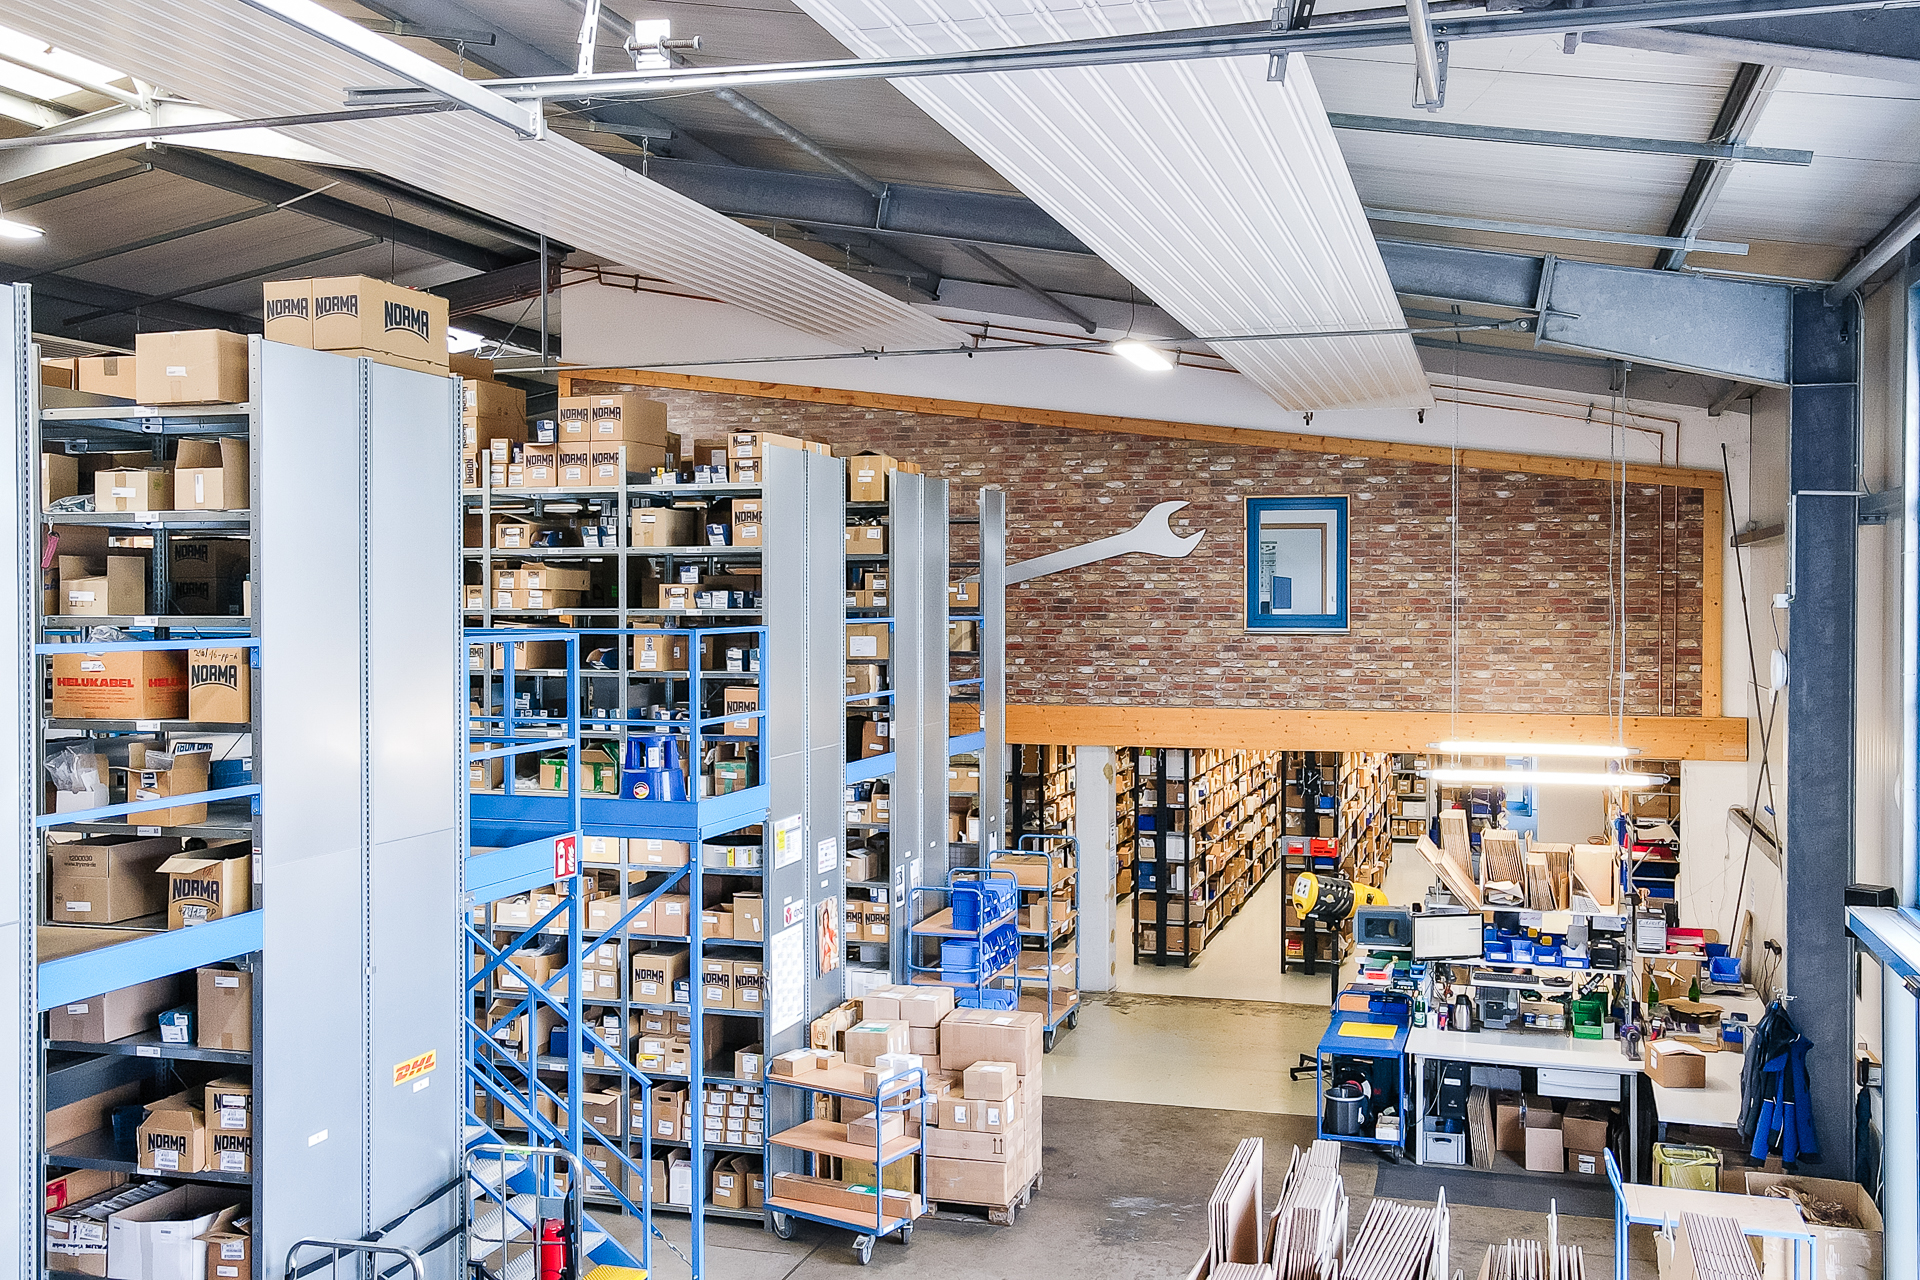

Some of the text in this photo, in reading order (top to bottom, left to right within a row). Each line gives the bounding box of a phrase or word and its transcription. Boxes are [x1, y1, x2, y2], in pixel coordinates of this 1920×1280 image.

[267, 298, 308, 318] NORMA
[316, 295, 358, 316] NORMA
[385, 301, 429, 339] NORMA
[560, 409, 589, 421] NORMA
[593, 407, 621, 420] NORMA
[526, 455, 553, 467] NORMA
[560, 453, 588, 467] NORMA
[466, 459, 474, 484] NORMA
[57, 678, 134, 687] HELUKABEL
[192, 665, 237, 687] NORMA
[727, 702, 755, 712] NORMA
[173, 879, 219, 903] NORMA
[635, 969, 663, 983] NORMA
[395, 1053, 436, 1082] DHL
[147, 1133, 186, 1154] NORMA
